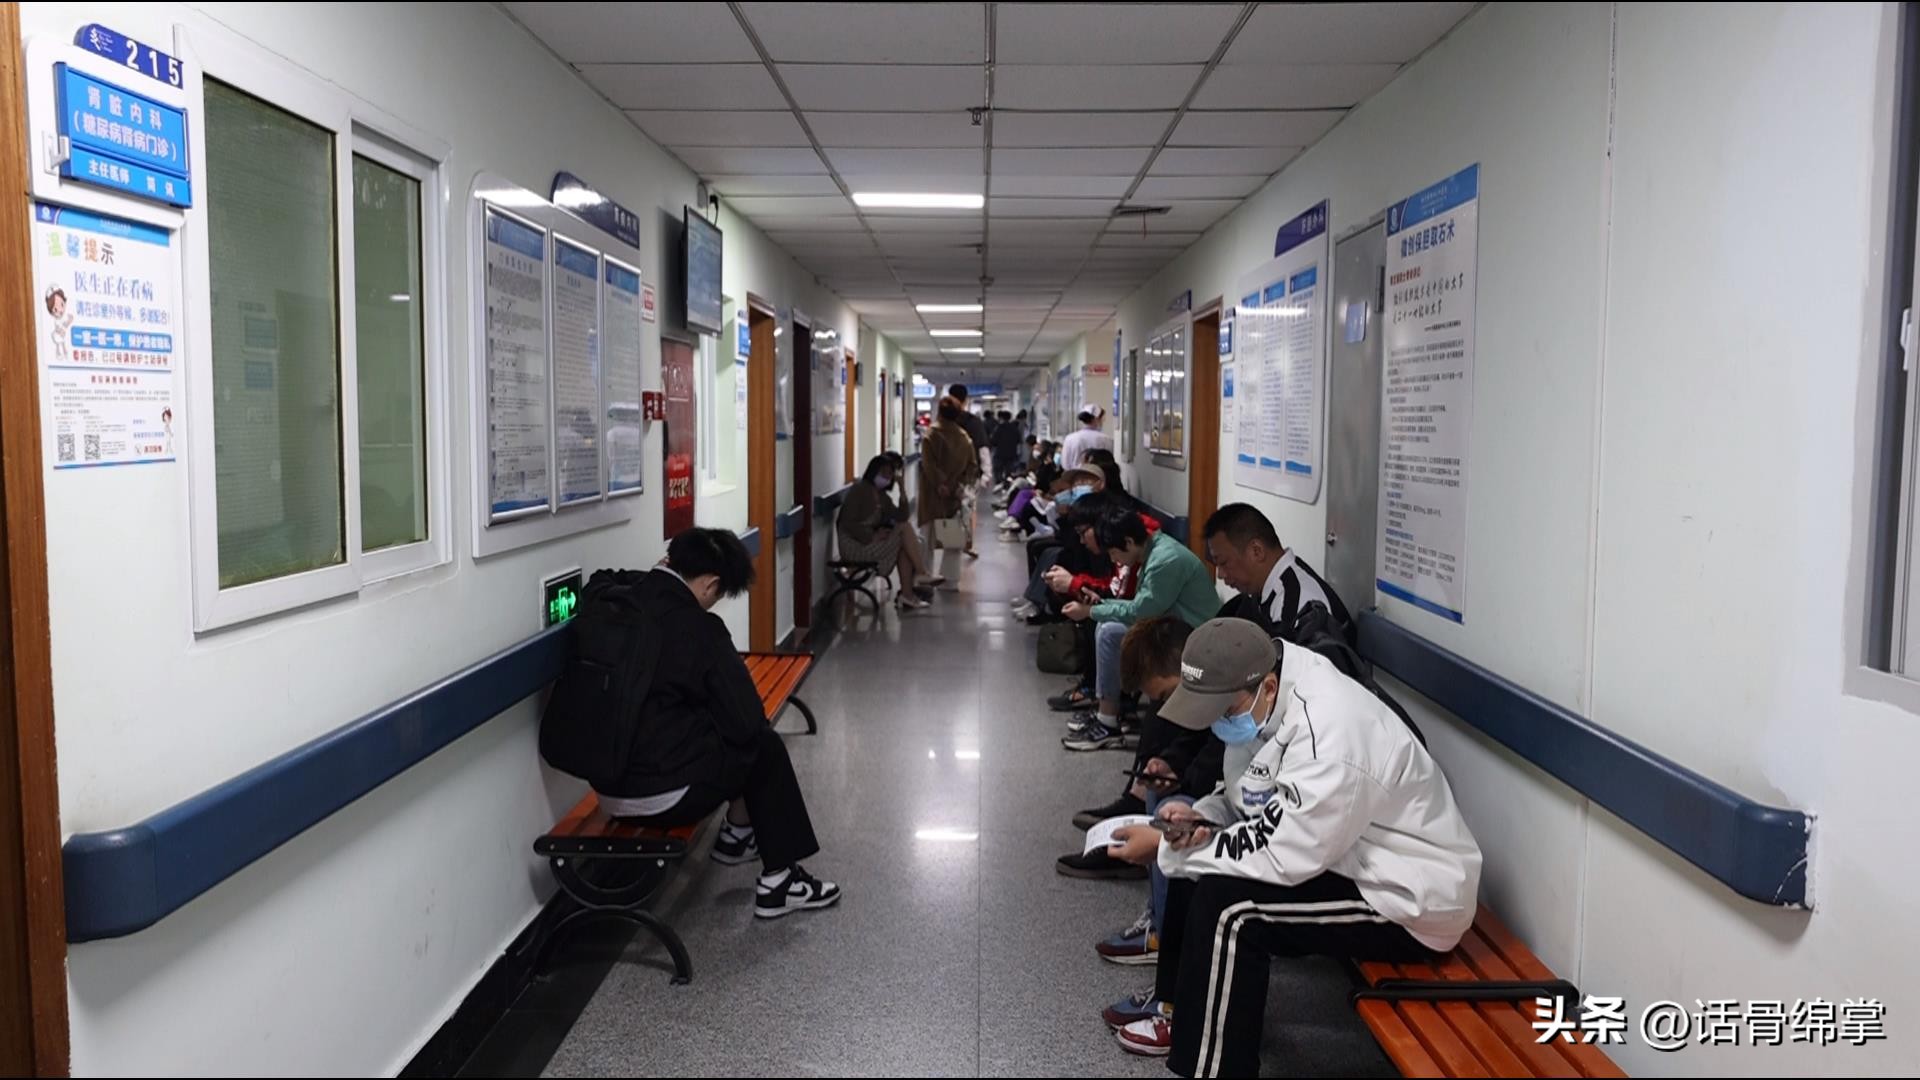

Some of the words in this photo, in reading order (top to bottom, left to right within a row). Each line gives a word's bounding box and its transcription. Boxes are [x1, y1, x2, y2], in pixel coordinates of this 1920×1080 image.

[126, 39, 181, 86] 215
[87, 84, 163, 131] 肾脏内科
[88, 158, 131, 186] 主任医师
[46, 231, 115, 266] 温馨提示
[74, 270, 155, 302] 医生正在看病
